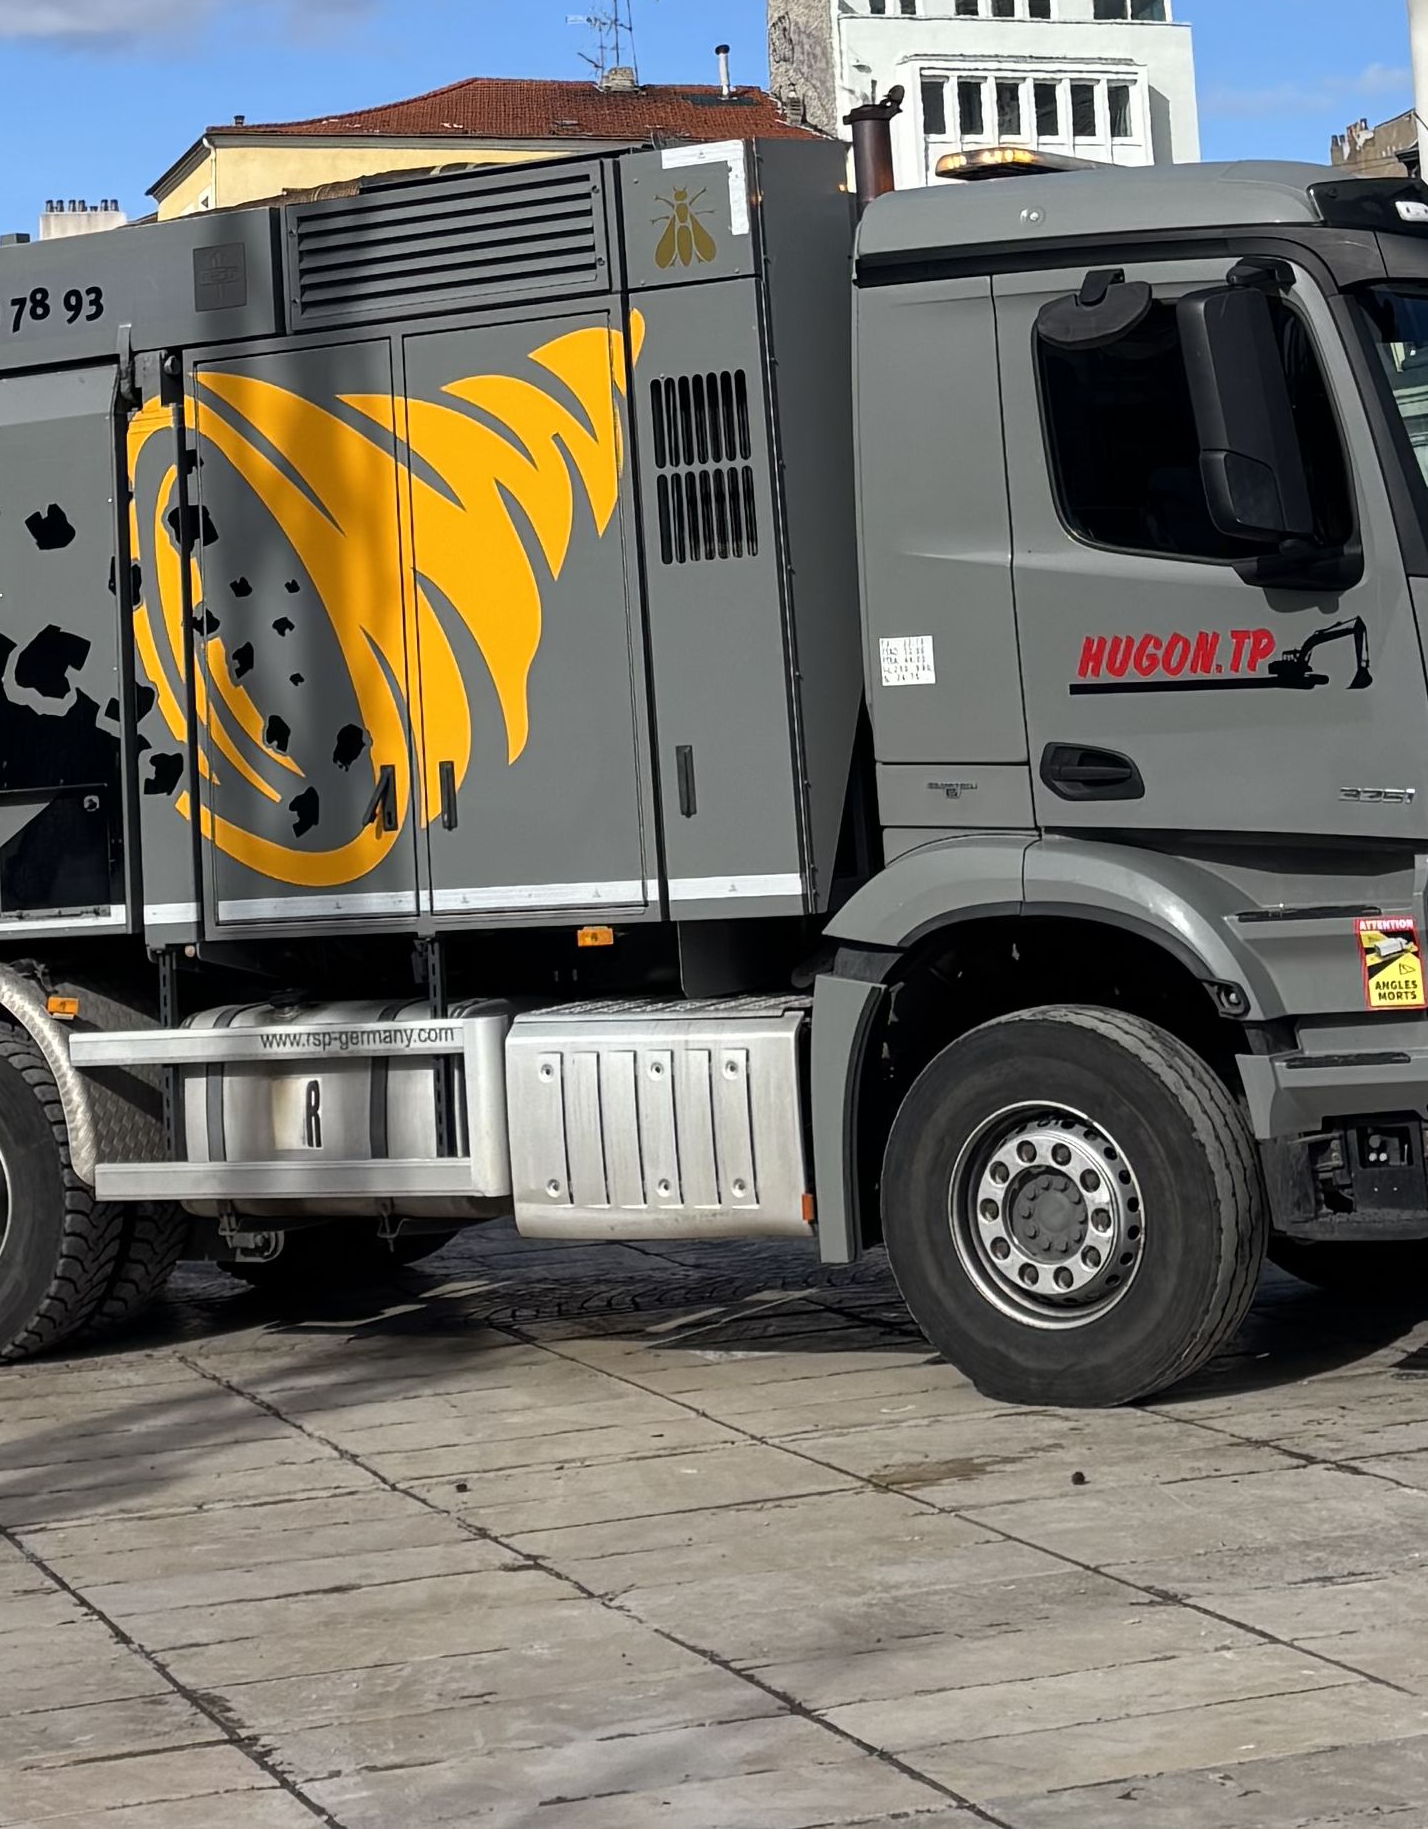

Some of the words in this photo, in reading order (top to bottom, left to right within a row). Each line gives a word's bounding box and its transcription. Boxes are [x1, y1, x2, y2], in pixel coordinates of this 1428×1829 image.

[10, 287, 51, 333] 78
[63, 286, 104, 324] 93
[1077, 628, 1276, 679] HUGON.TP
[1359, 919, 1414, 931] ATTENTION
[1375, 980, 1418, 991] ANGLES
[1378, 991, 1417, 1001] MORTS
[260, 1027, 455, 1051] www.rsp-germany.com
